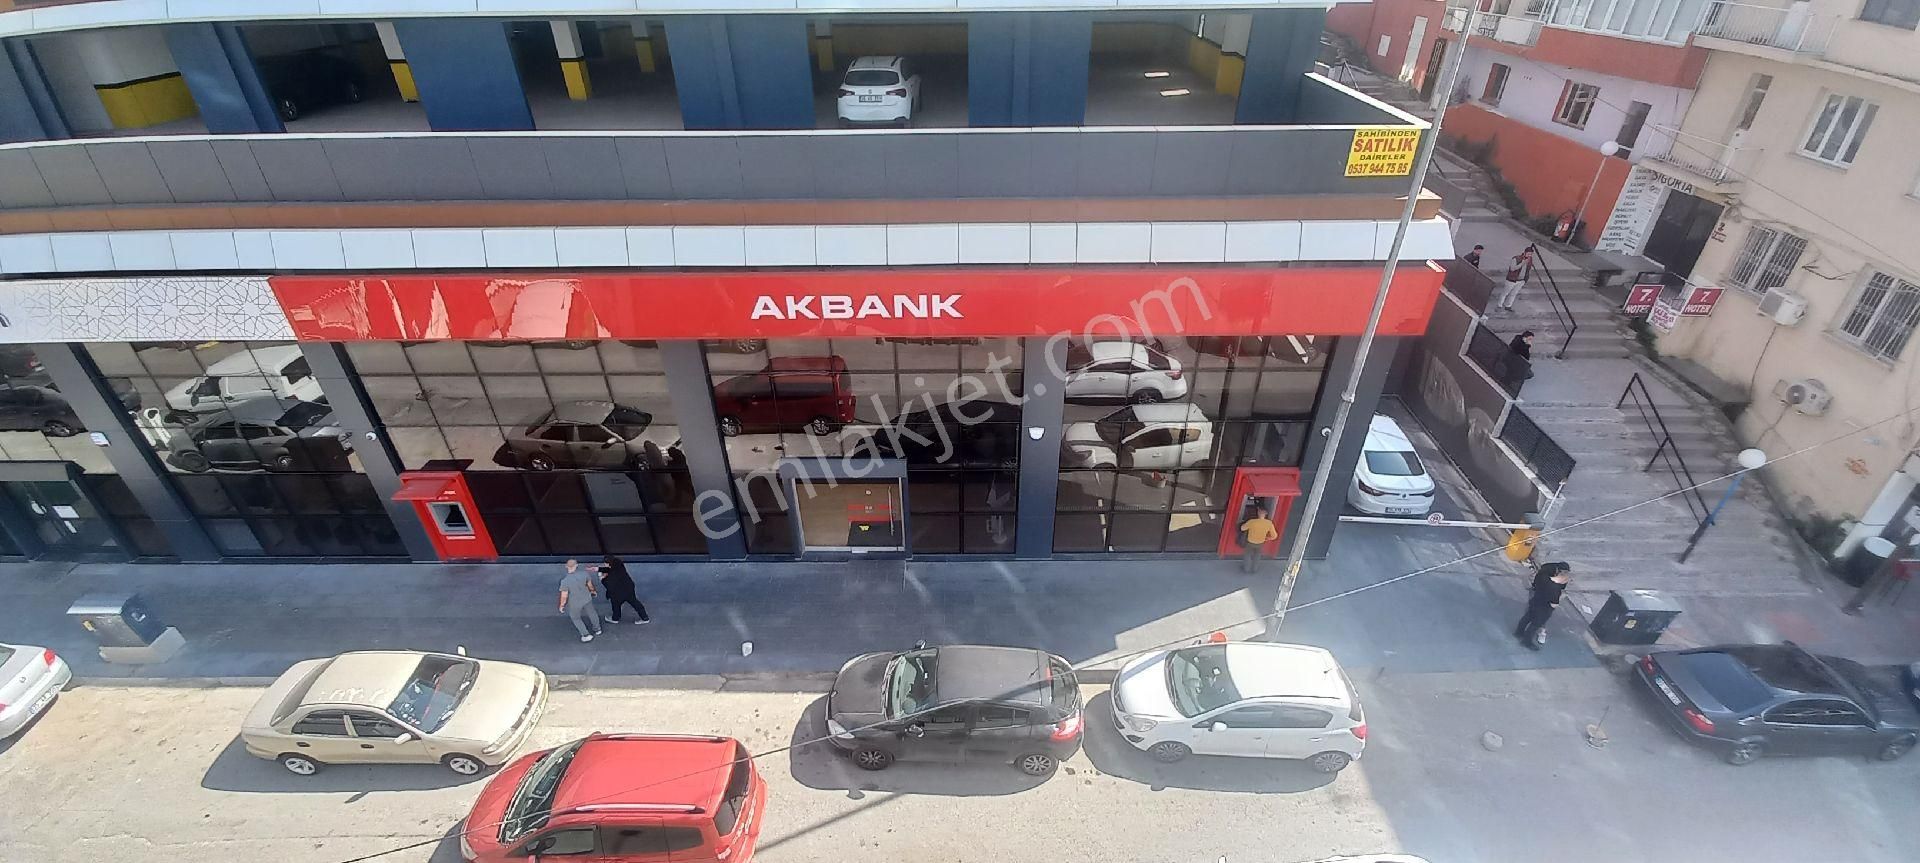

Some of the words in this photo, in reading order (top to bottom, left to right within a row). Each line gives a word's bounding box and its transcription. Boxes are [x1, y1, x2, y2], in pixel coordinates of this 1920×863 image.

[1354, 138, 1415, 152] SATILIK
[1348, 164, 1368, 174] 0537
[1369, 163, 1385, 173] 944
[1386, 163, 1396, 173] 75
[1639, 289, 1654, 302] 7.
[1700, 291, 1711, 303] 7.
[749, 294, 964, 320] AKBANK
[1684, 304, 1711, 313] NOTER
